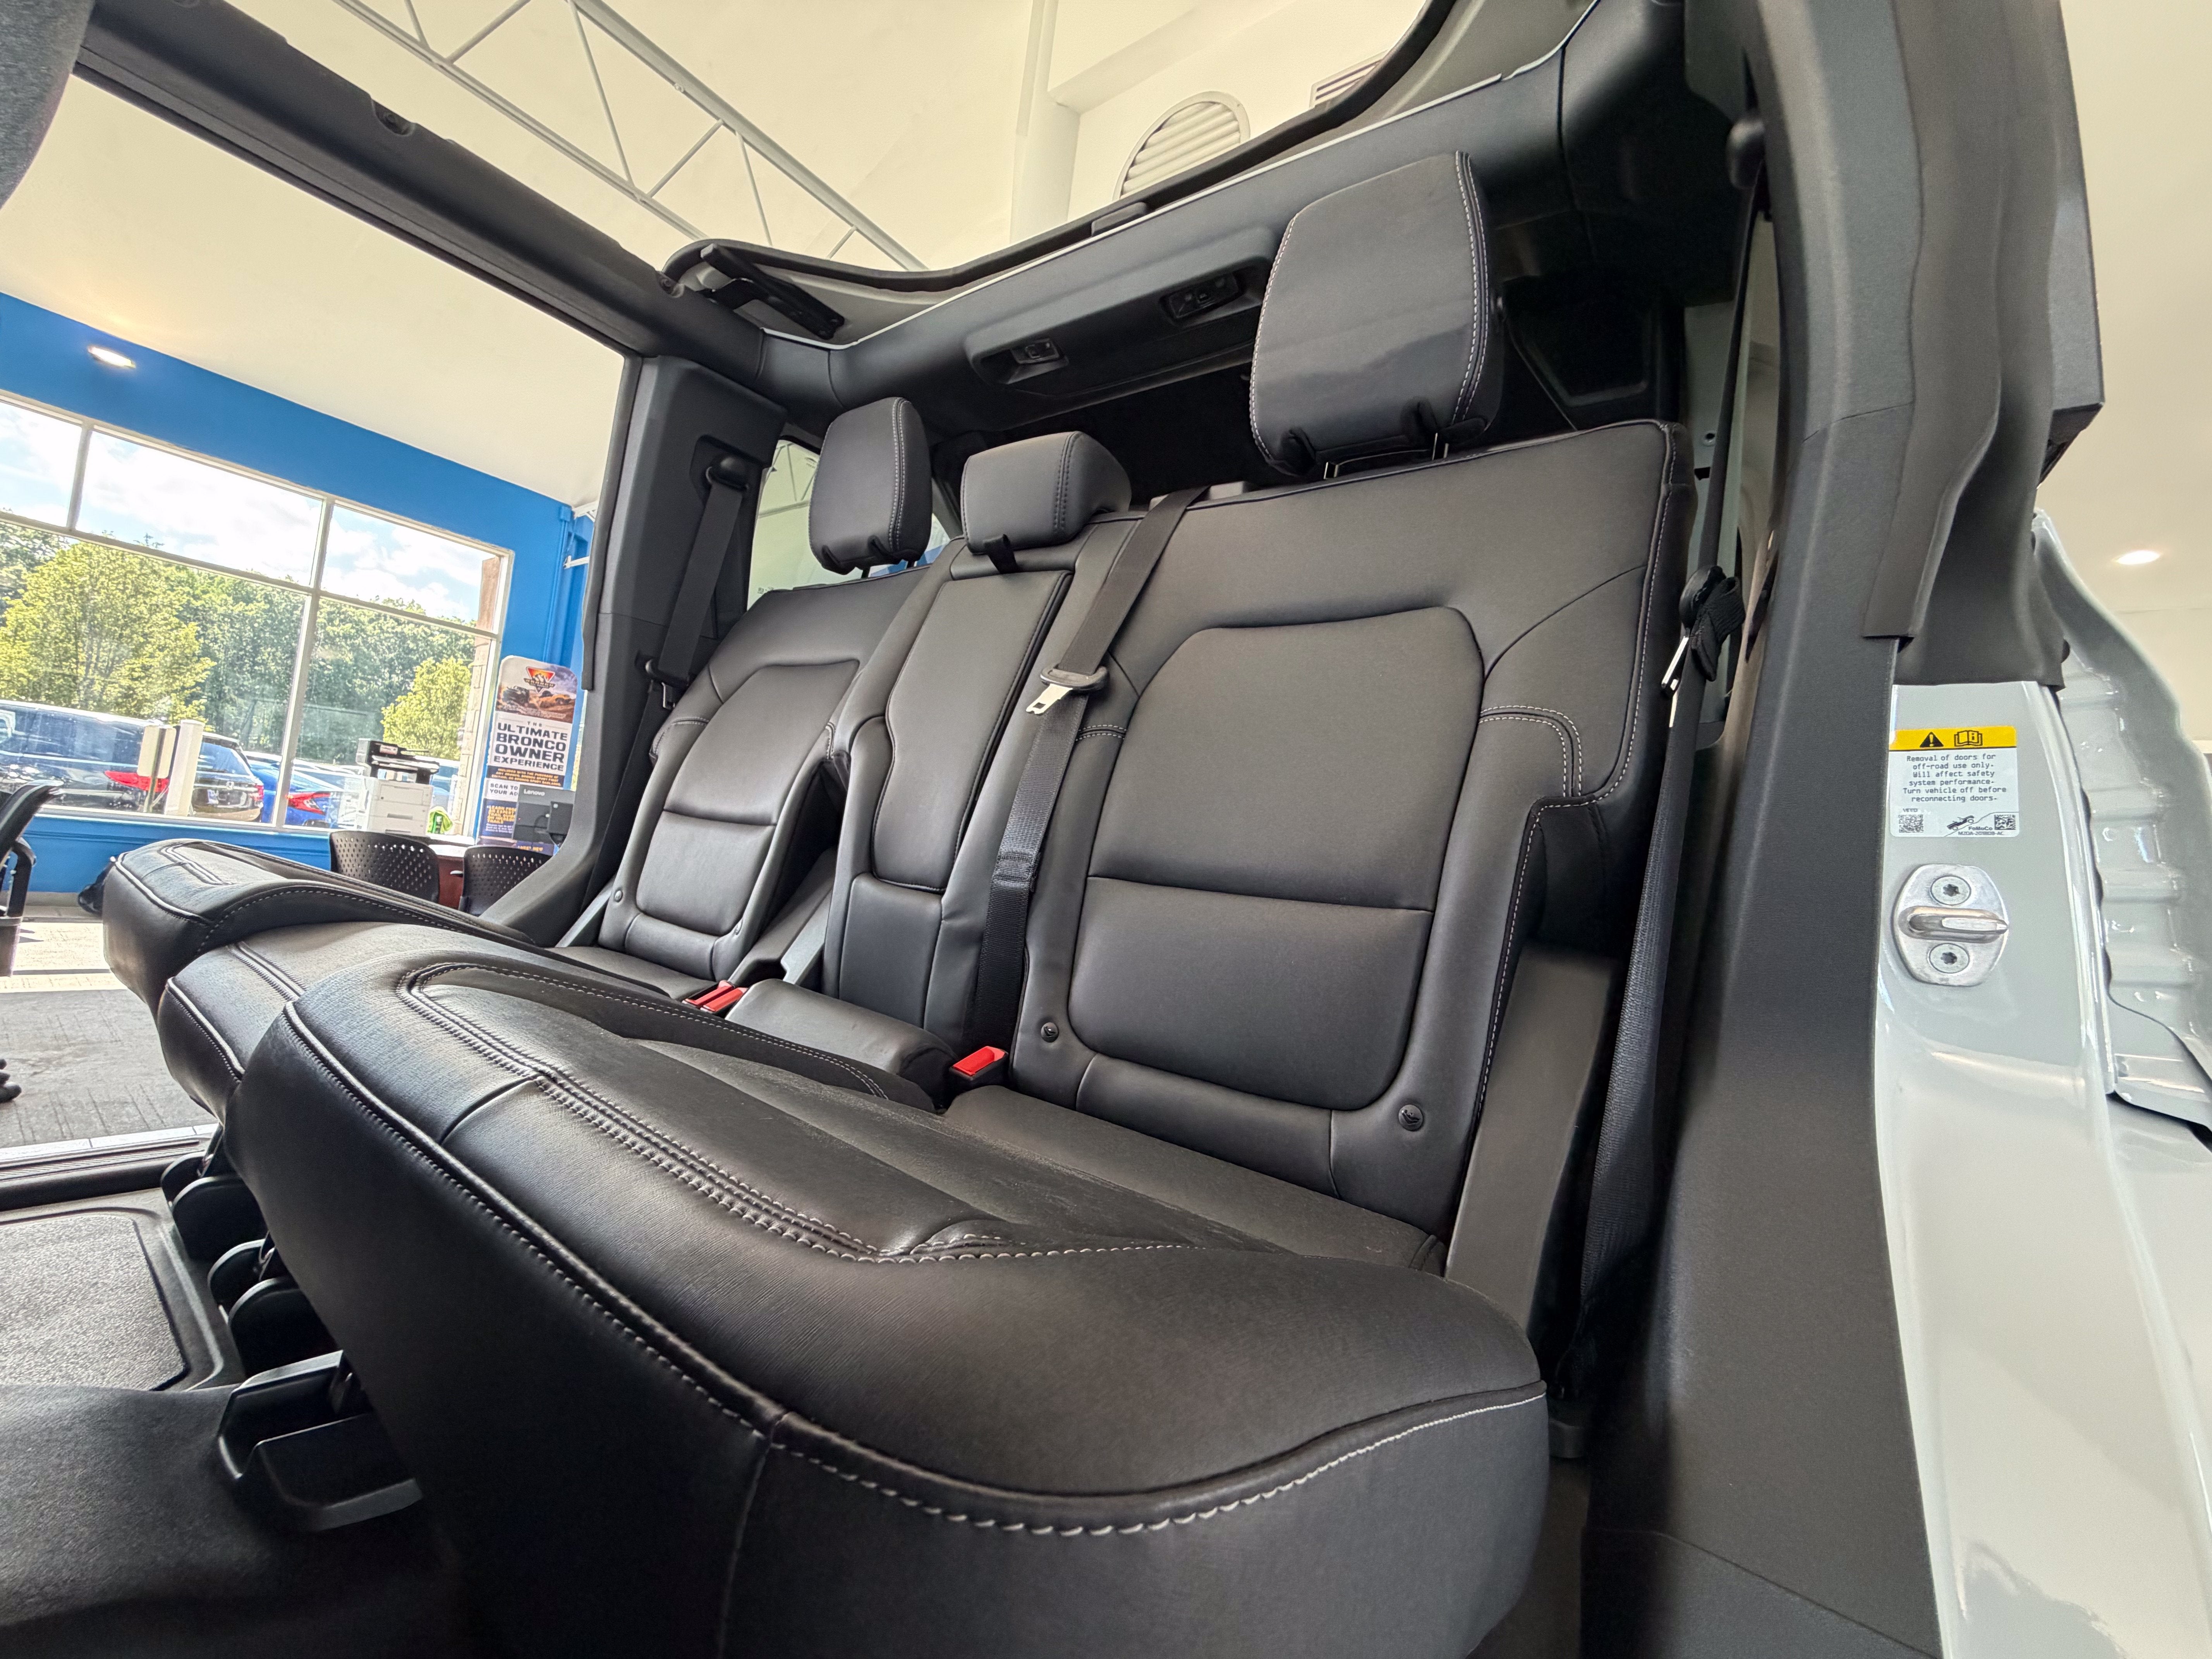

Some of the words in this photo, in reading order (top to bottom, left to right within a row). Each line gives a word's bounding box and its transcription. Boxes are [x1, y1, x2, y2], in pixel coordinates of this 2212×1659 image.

[498, 722, 568, 741] ULTIMATE
[496, 732, 566, 752] BRONCO
[494, 756, 564, 771] EXPERIENCE
[495, 744, 564, 764] OWNER
